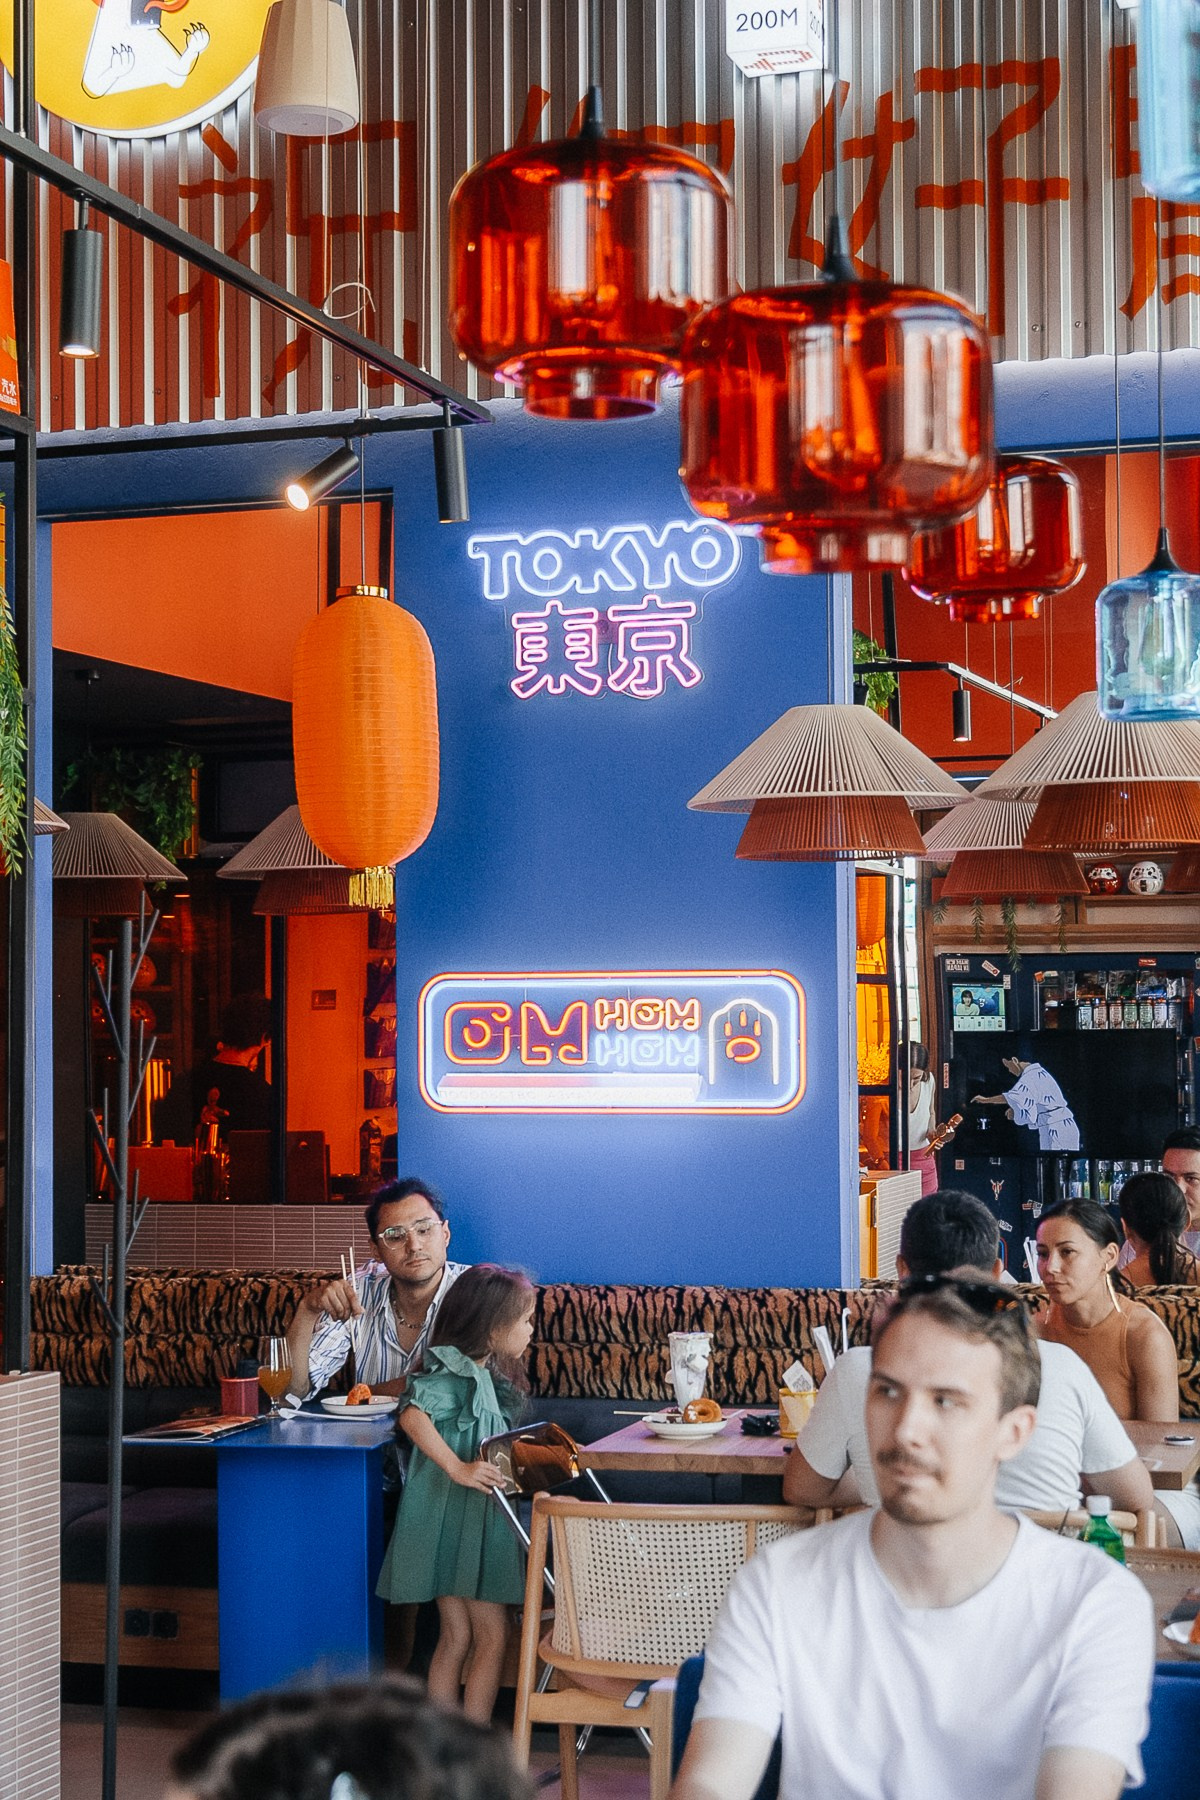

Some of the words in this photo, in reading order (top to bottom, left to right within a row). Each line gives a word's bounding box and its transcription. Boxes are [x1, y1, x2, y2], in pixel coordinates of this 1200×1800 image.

[736, 8, 798, 32] 200M
[467, 518, 741, 599] TOKYO
[510, 594, 702, 699] 東京
